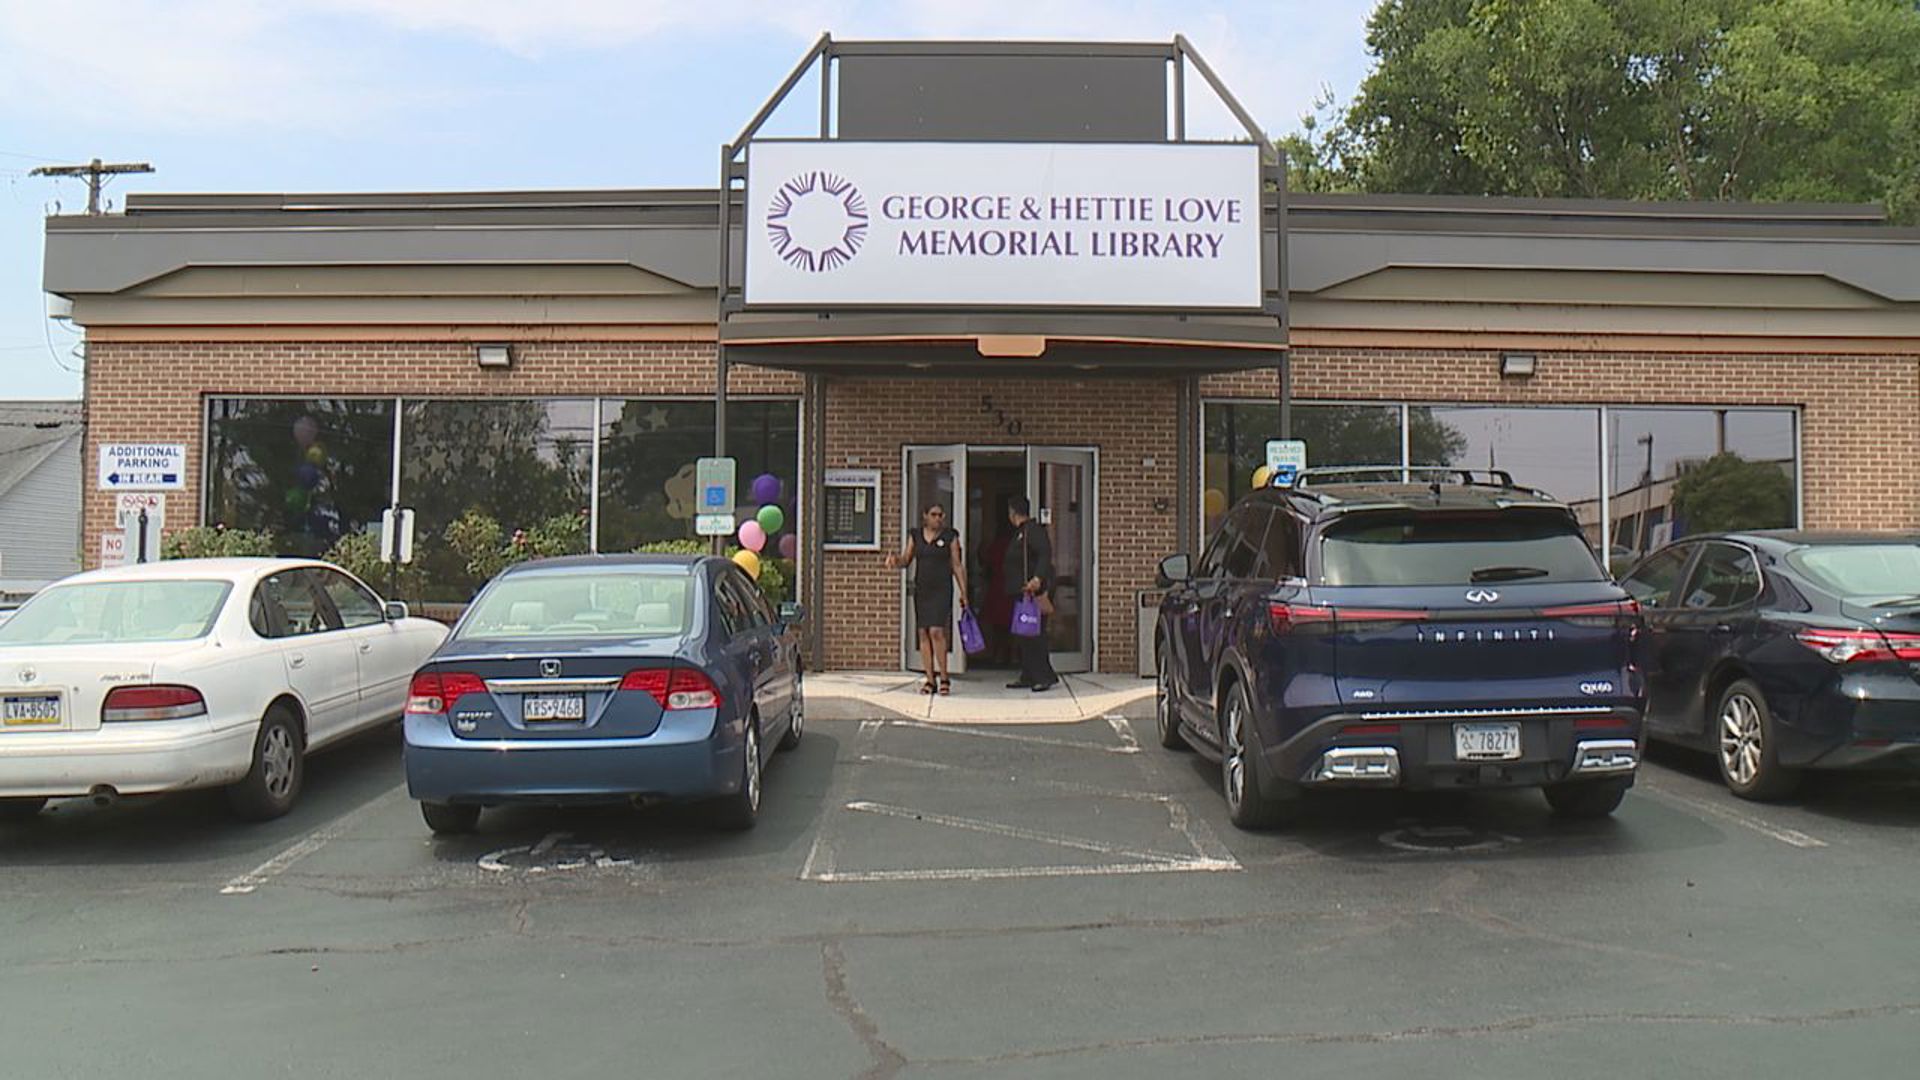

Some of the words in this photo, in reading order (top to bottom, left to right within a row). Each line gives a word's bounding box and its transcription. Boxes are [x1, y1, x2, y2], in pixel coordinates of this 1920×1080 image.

[882, 195, 1011, 220] GEORGE
[1019, 196, 1043, 221] &
[1050, 196, 1153, 222] HETTIE
[1165, 198, 1241, 224] LOVE
[898, 230, 1079, 256] MEMORIAL
[1092, 231, 1224, 259] LIBRARY
[108, 446, 180, 457] ADDITIONAL
[118, 458, 170, 468] PARKING
[105, 539, 123, 551] NO
[1417, 629, 1554, 643] INFINITI
